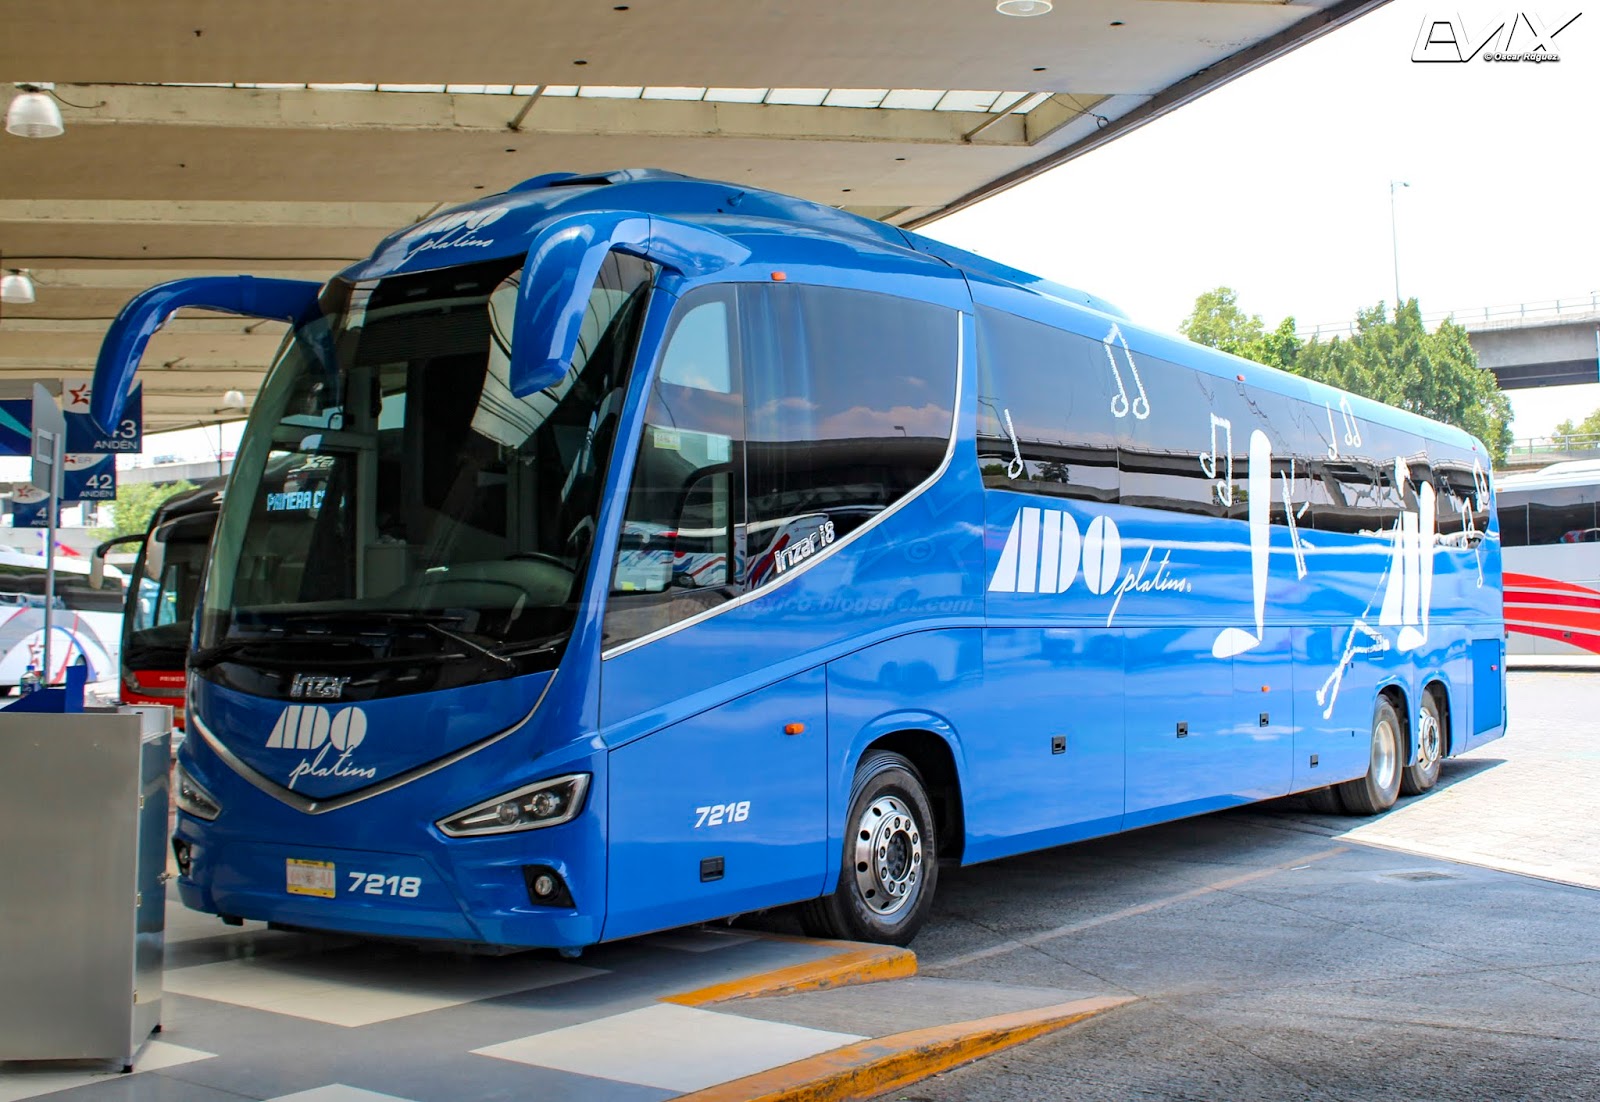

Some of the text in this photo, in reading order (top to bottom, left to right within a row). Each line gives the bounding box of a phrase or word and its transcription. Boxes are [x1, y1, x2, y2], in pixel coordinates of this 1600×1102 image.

[394, 224, 495, 270] platino
[112, 419, 138, 439] 3
[85, 474, 113, 490] 42
[36, 507, 47, 518] 4
[266, 490, 326, 512] PRIMERA C
[819, 520, 835, 547] i8
[987, 506, 1122, 595] ADO
[159, 675, 186, 683] PRIMER
[265, 705, 368, 751] ADO
[287, 741, 377, 790] platino
[694, 800, 751, 829] 7218
[348, 871, 422, 898] 7218
